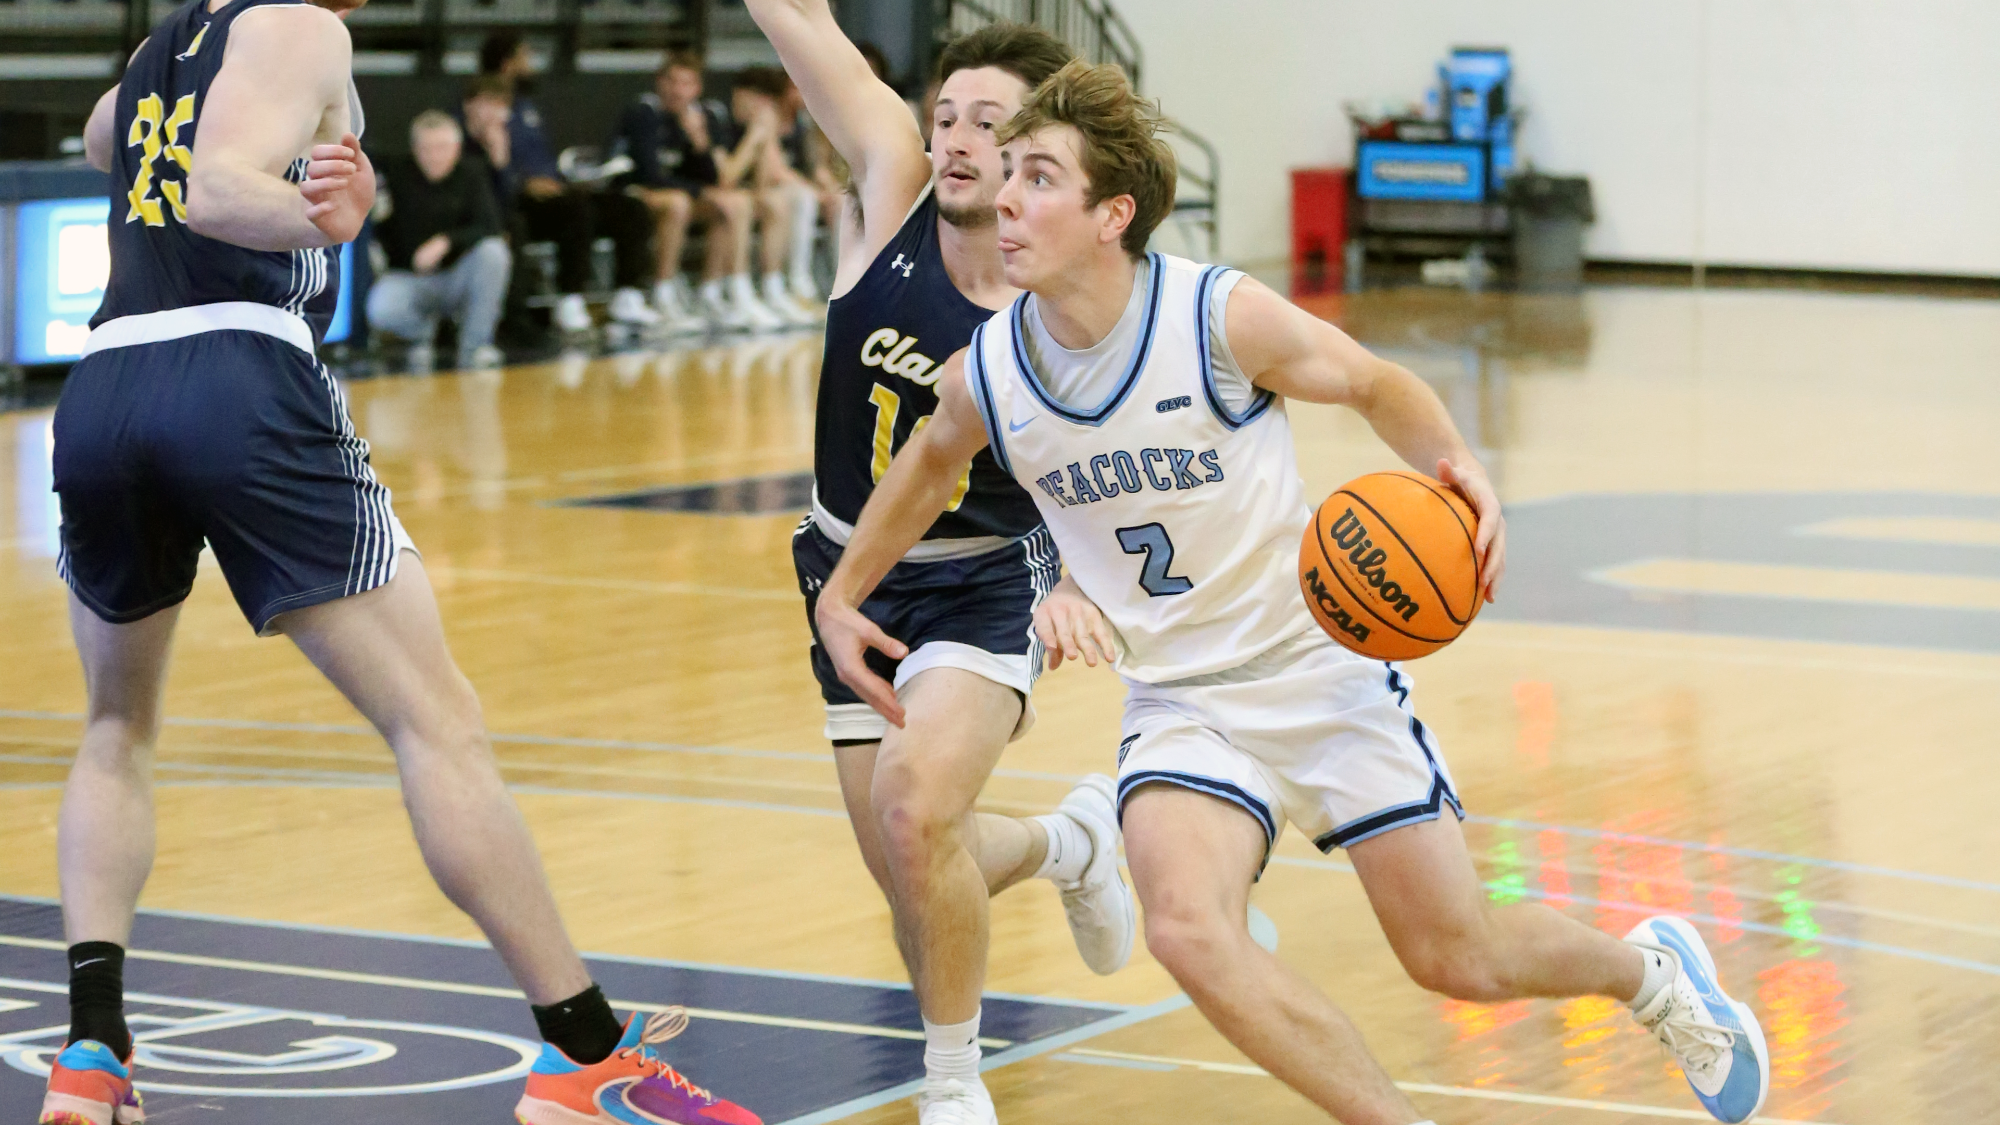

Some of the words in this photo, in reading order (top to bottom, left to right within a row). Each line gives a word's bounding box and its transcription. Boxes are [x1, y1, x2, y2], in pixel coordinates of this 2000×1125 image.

[125, 90, 196, 227] 25
[1155, 395, 1192, 413] GLVC
[1036, 448, 1224, 508] PEACOCKS
[1115, 522, 1194, 597] 2
[1330, 507, 1419, 622] Wilson
[1305, 566, 1371, 643] NCAA
